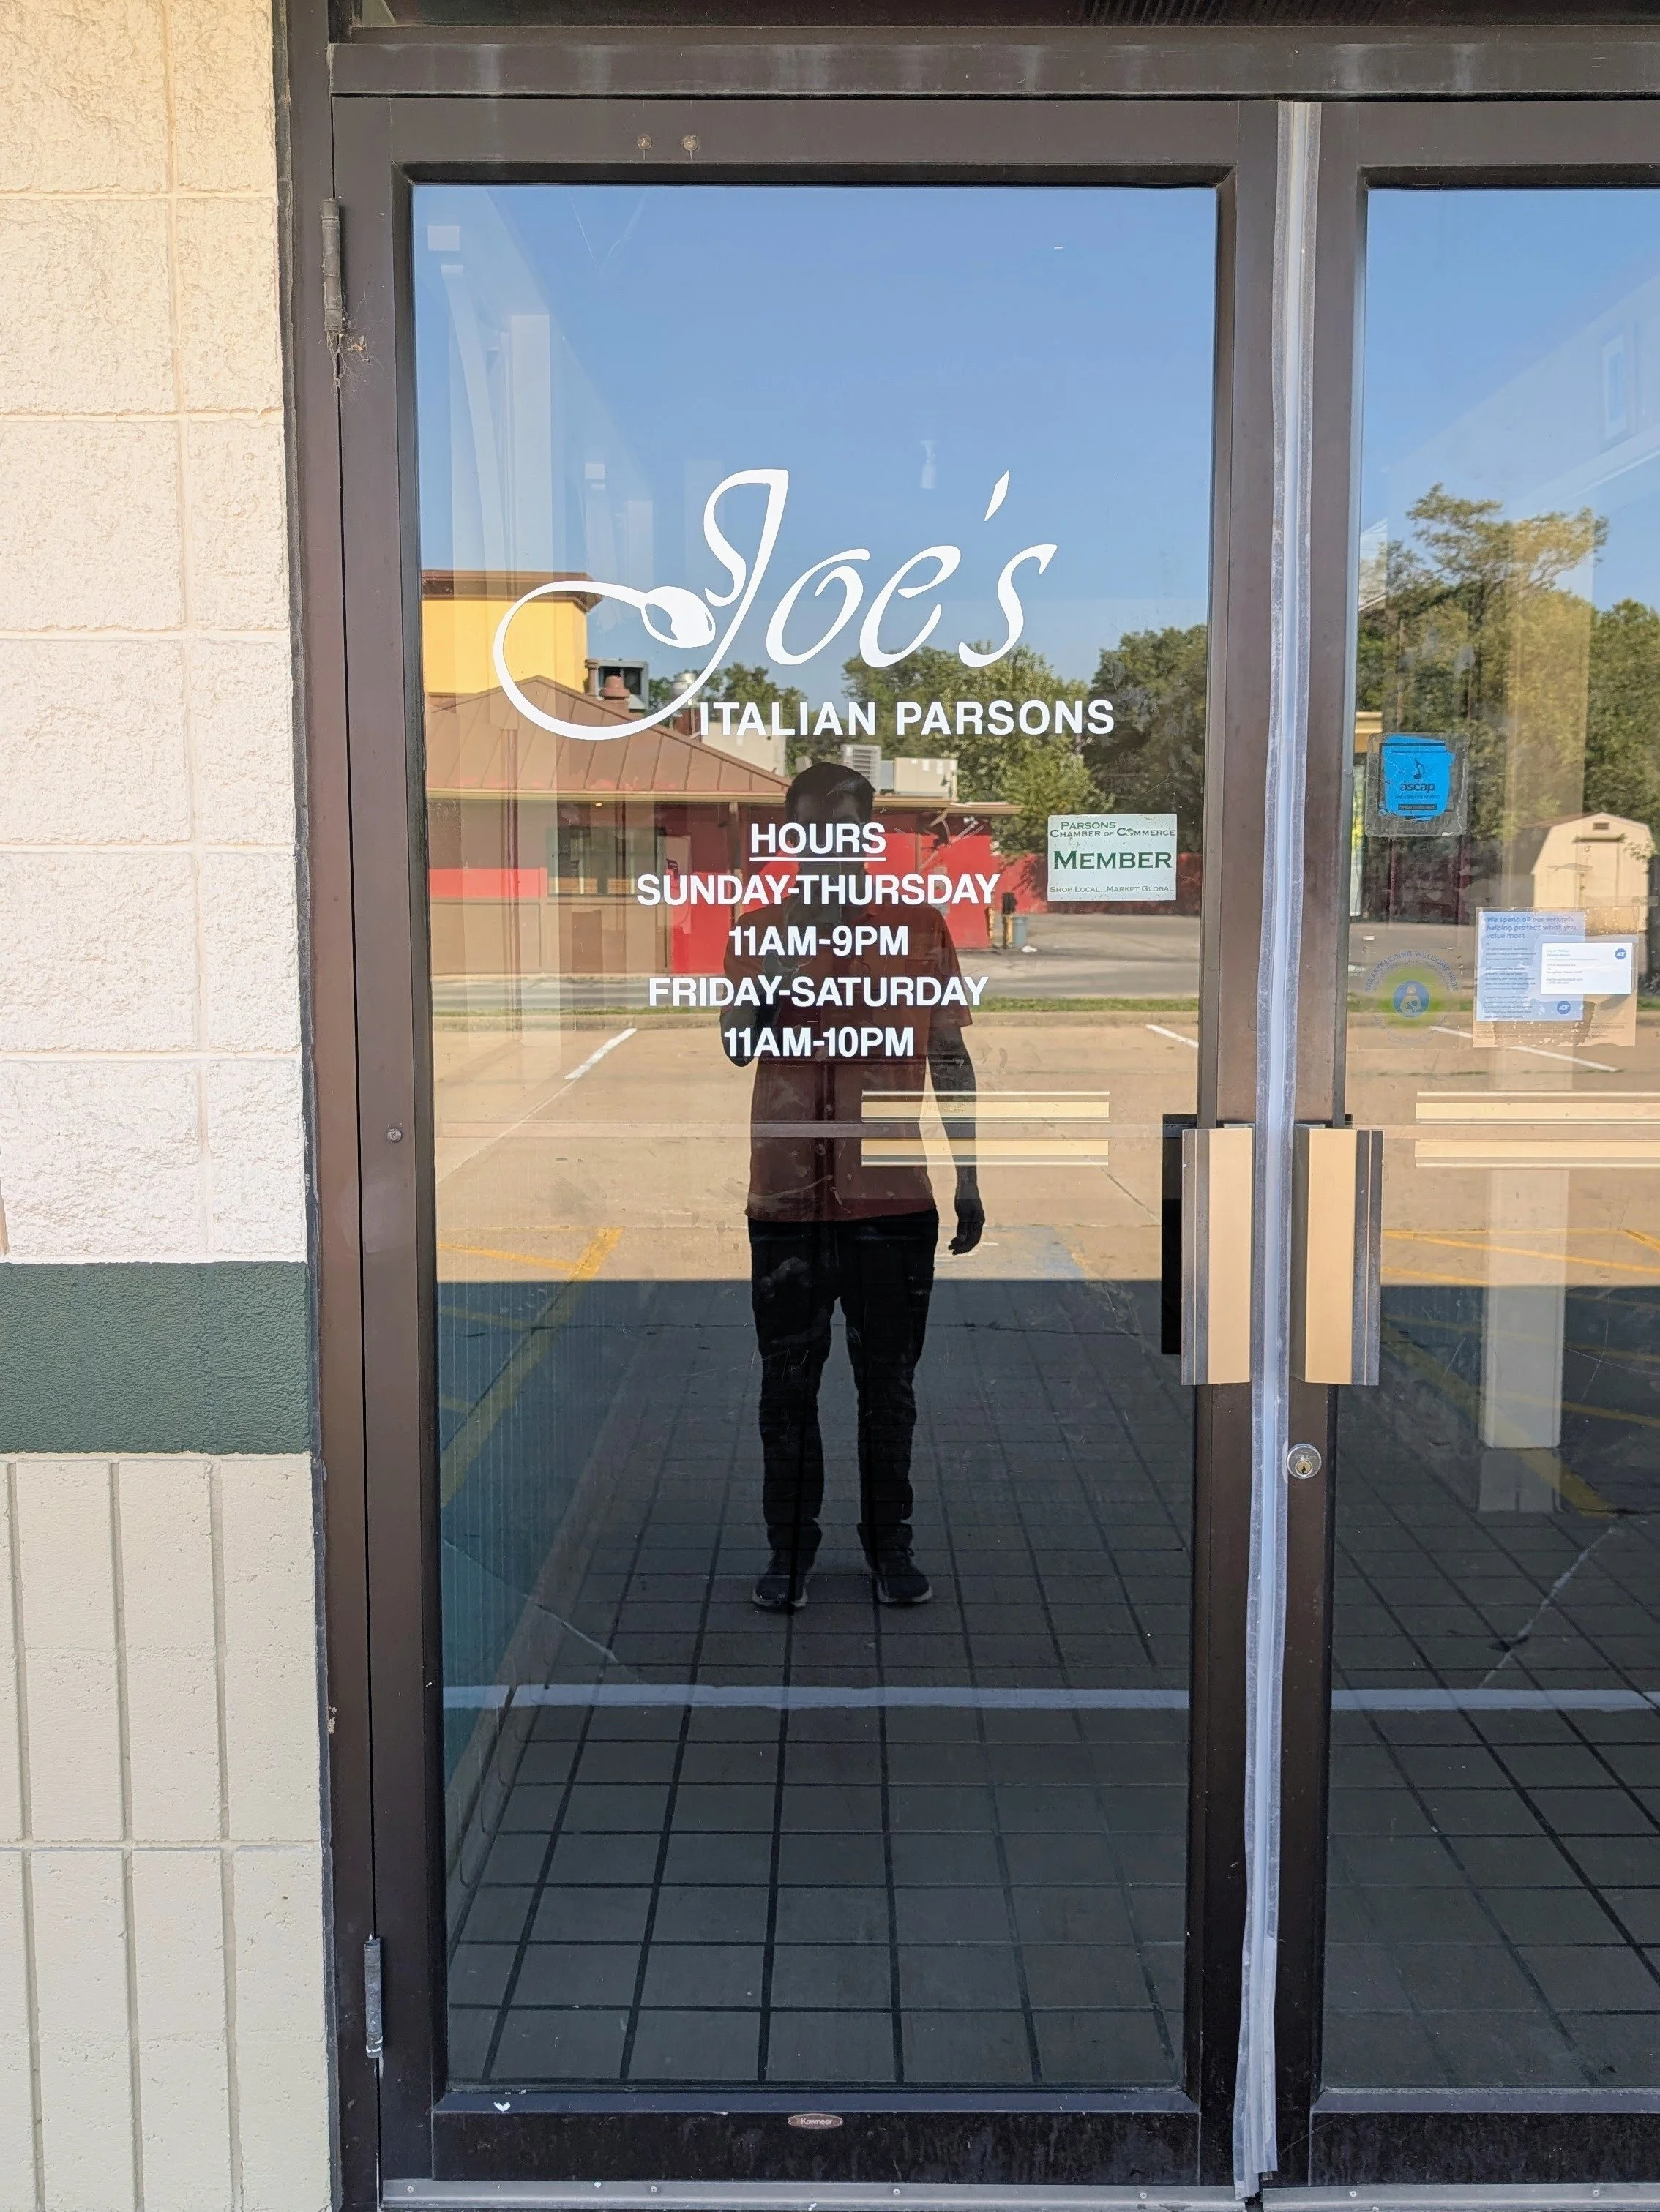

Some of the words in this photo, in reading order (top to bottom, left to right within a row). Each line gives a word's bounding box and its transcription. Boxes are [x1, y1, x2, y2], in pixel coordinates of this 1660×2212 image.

[493, 468, 1058, 740] Joe's
[700, 701, 876, 735] ITALIAN
[896, 699, 1115, 735] PARSONS
[1399, 782, 1436, 793] ascap
[751, 822, 886, 855] HOURS
[1053, 850, 1173, 870] MEMBER
[637, 874, 1001, 906] SUNDAY-THURSDAY
[1499, 916, 1520, 924] spend
[1514, 924, 1542, 932] protect
[728, 926, 908, 956] 11AM-9PM
[648, 975, 989, 1007] FRIDAY-SATURDAY
[724, 1027, 914, 1057] 11AM-10PM
